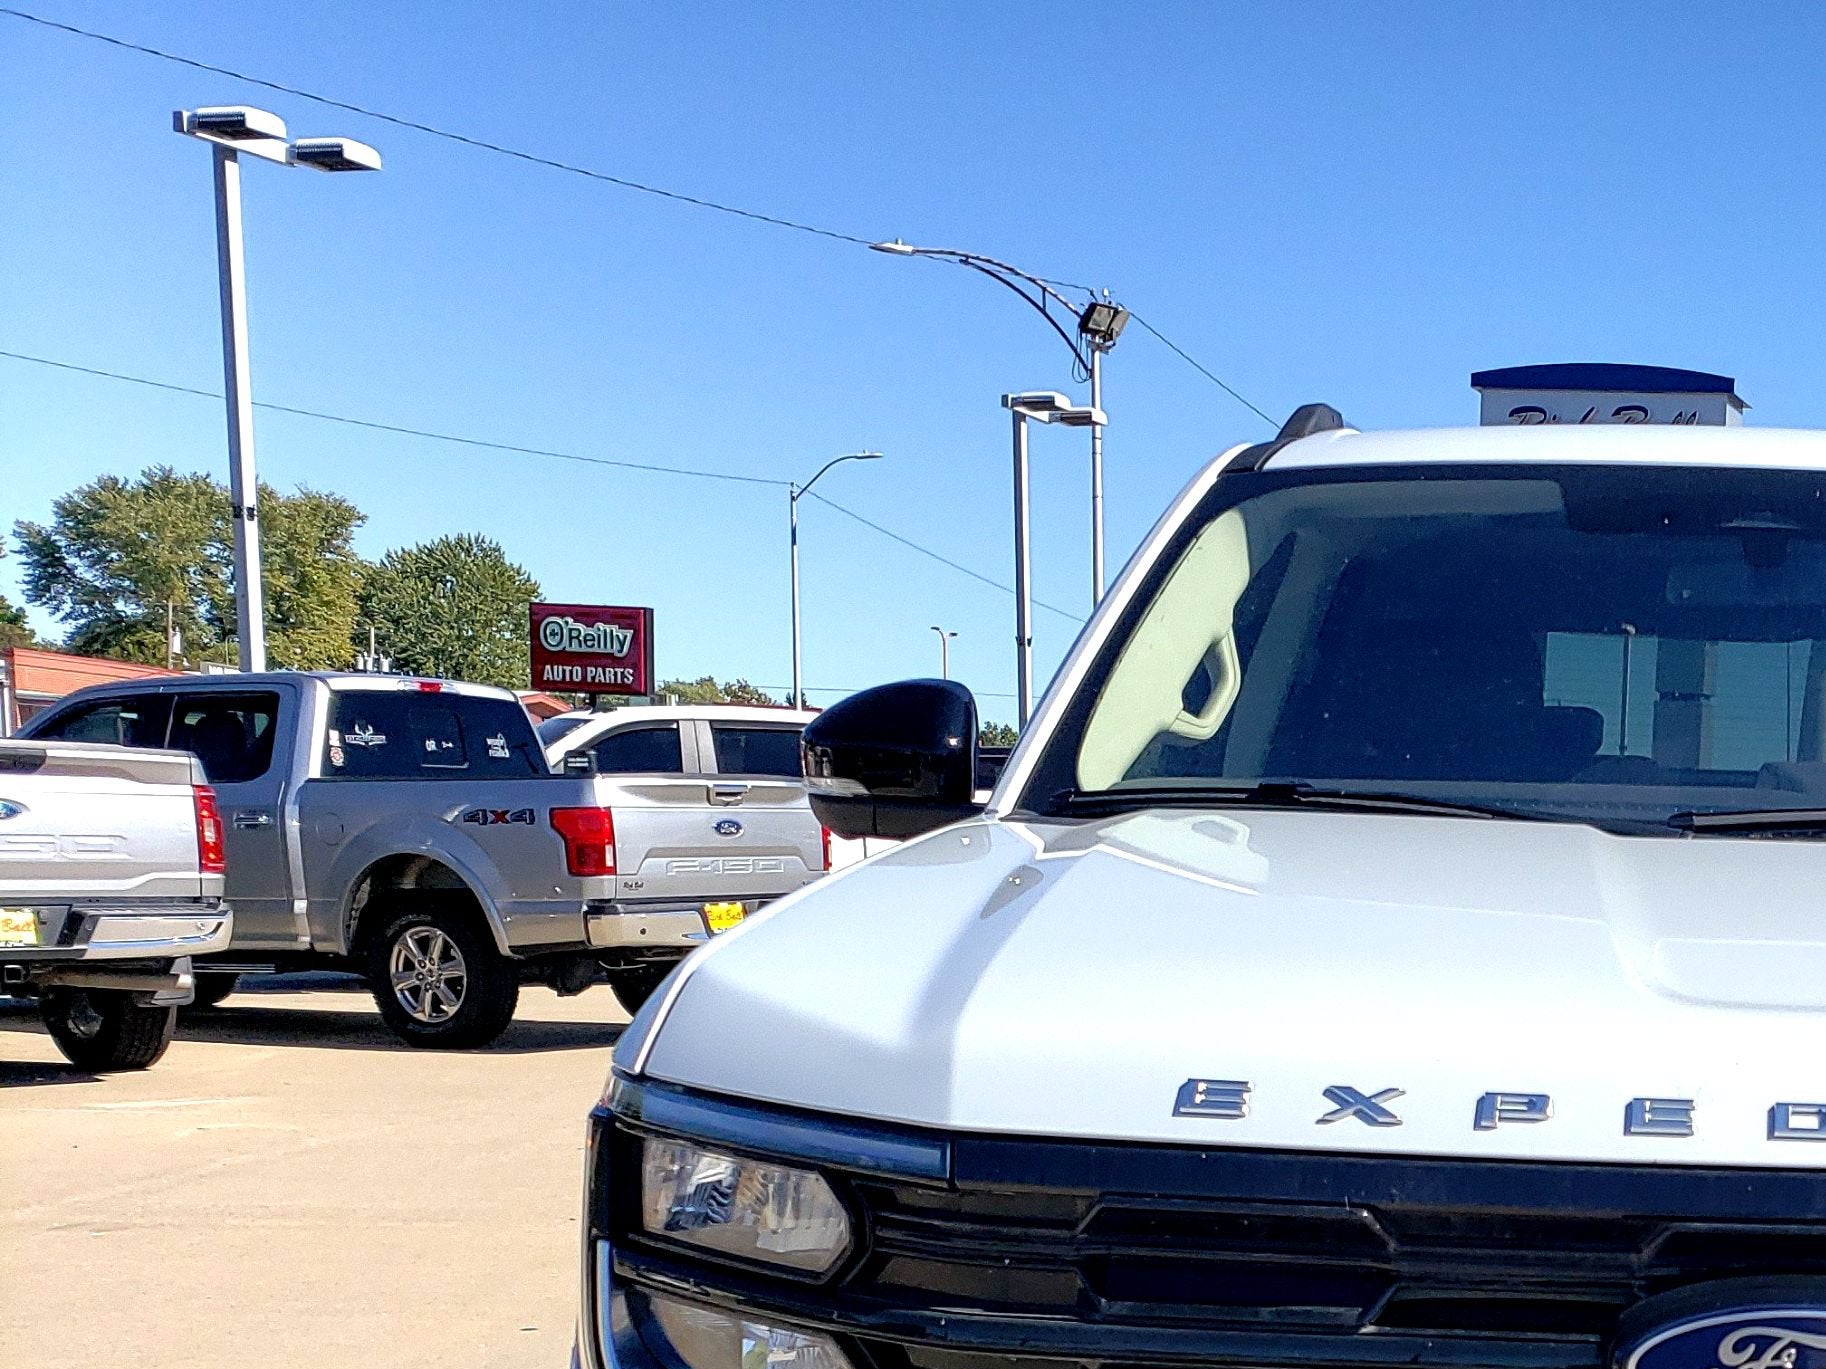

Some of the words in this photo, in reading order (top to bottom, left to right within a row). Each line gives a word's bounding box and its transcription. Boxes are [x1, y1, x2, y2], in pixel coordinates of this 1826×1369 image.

[541, 617, 632, 656] O'Reilly
[543, 664, 582, 682] AUTO
[586, 666, 634, 684] PARTS
